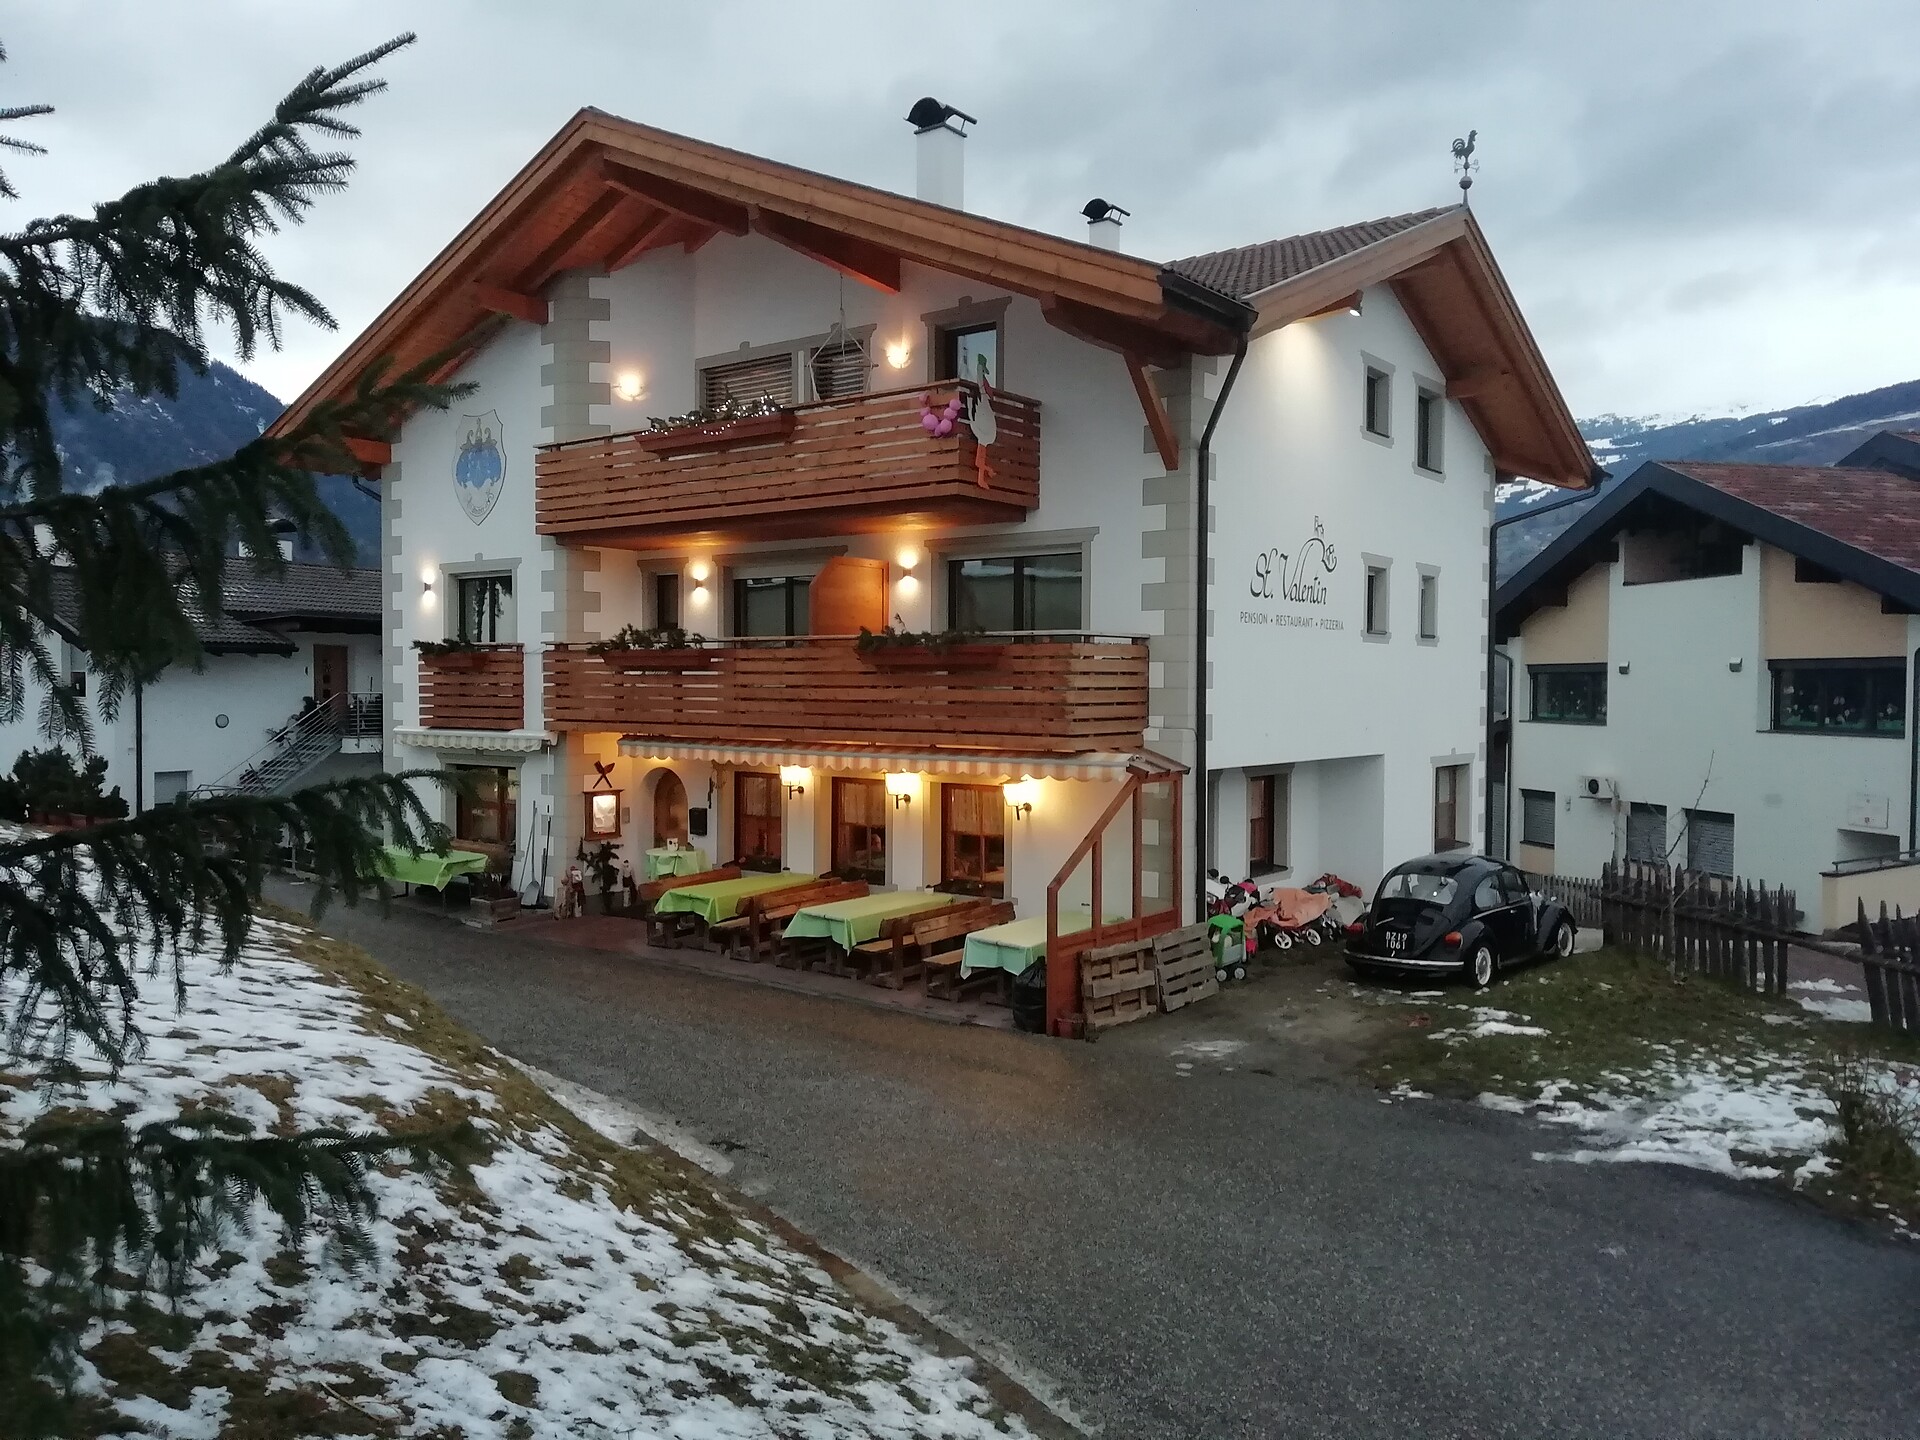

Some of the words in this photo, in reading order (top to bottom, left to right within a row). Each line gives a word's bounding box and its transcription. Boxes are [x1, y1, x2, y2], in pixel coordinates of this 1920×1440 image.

[1250, 547, 1278, 599] St.
[1279, 538, 1337, 605] Valentin
[1240, 611, 1268, 625] PENSION
[1275, 614, 1313, 628] RESTAURANT
[1319, 618, 1344, 631] PIZZERIA
[1386, 939, 1405, 950] 1061
